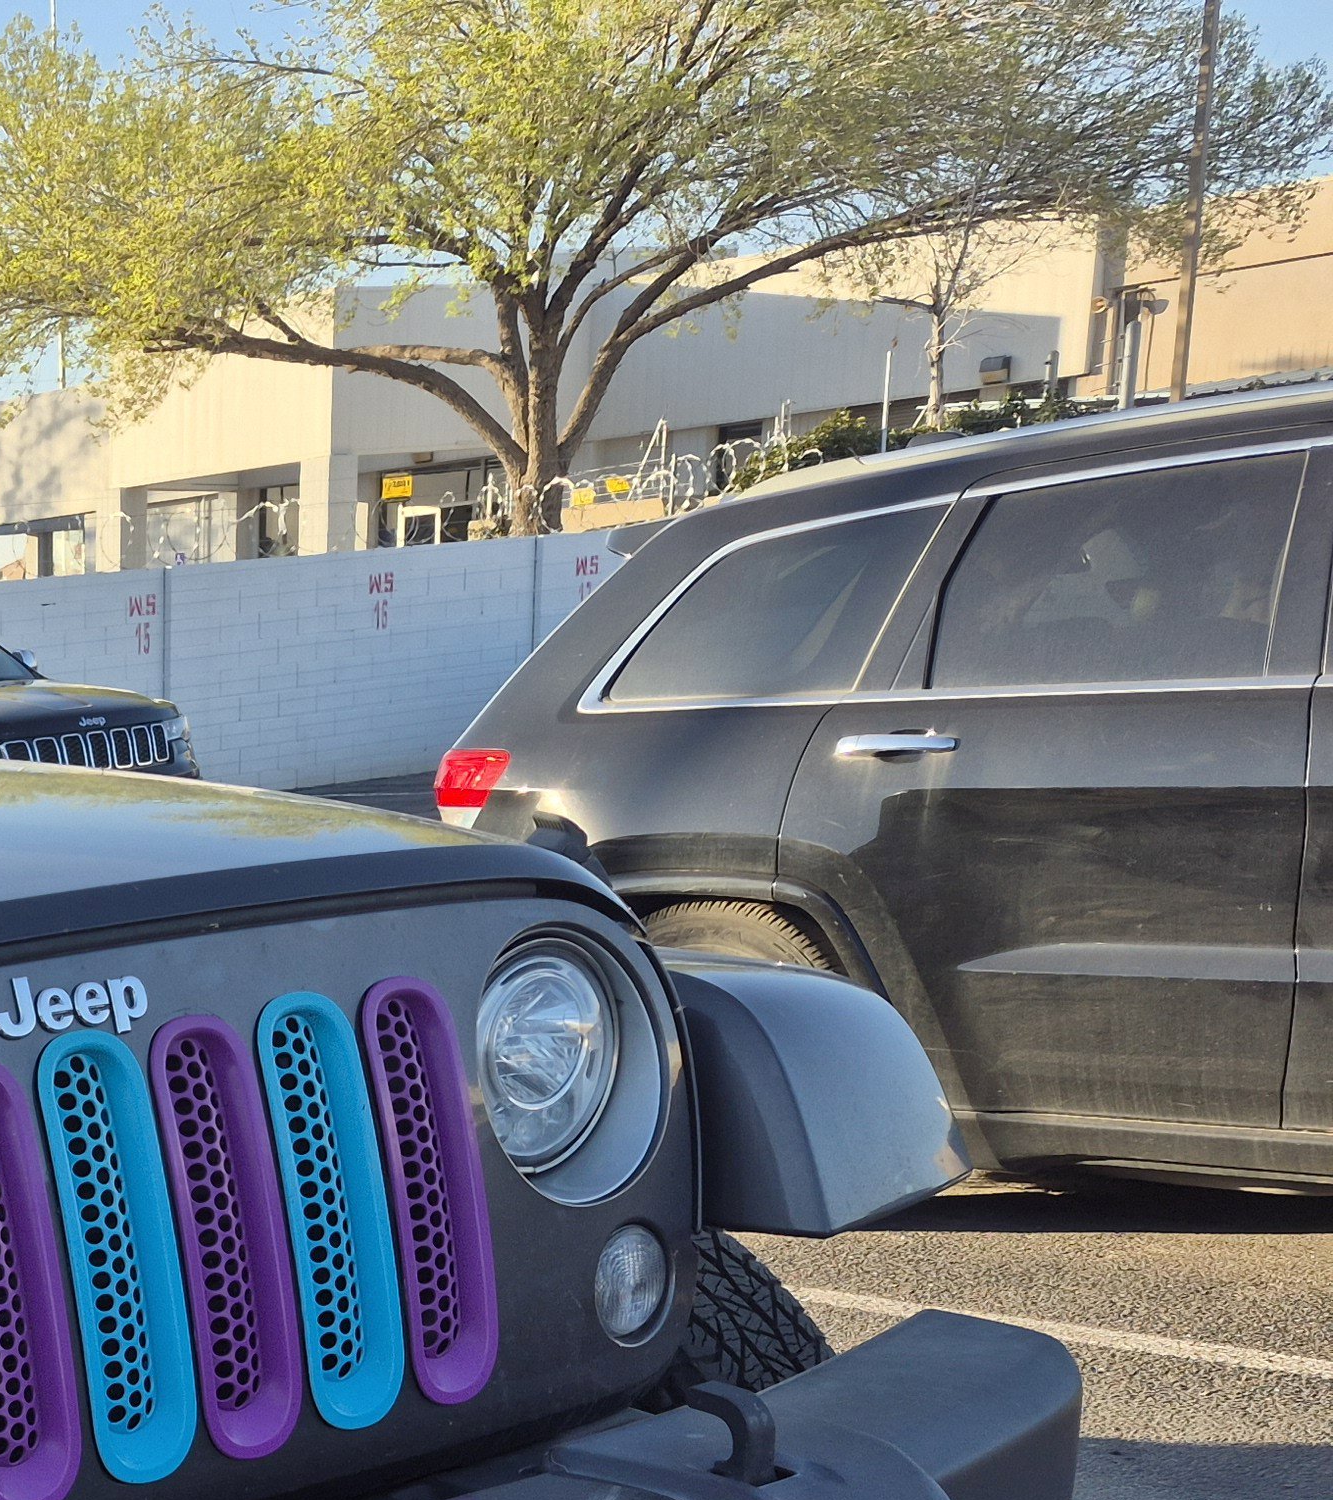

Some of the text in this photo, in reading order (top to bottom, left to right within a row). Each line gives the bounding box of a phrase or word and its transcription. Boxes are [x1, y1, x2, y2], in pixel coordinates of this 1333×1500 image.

[374, 599, 388, 630] 16
[135, 622, 150, 655] 15
[79, 716, 106, 727] Jeep
